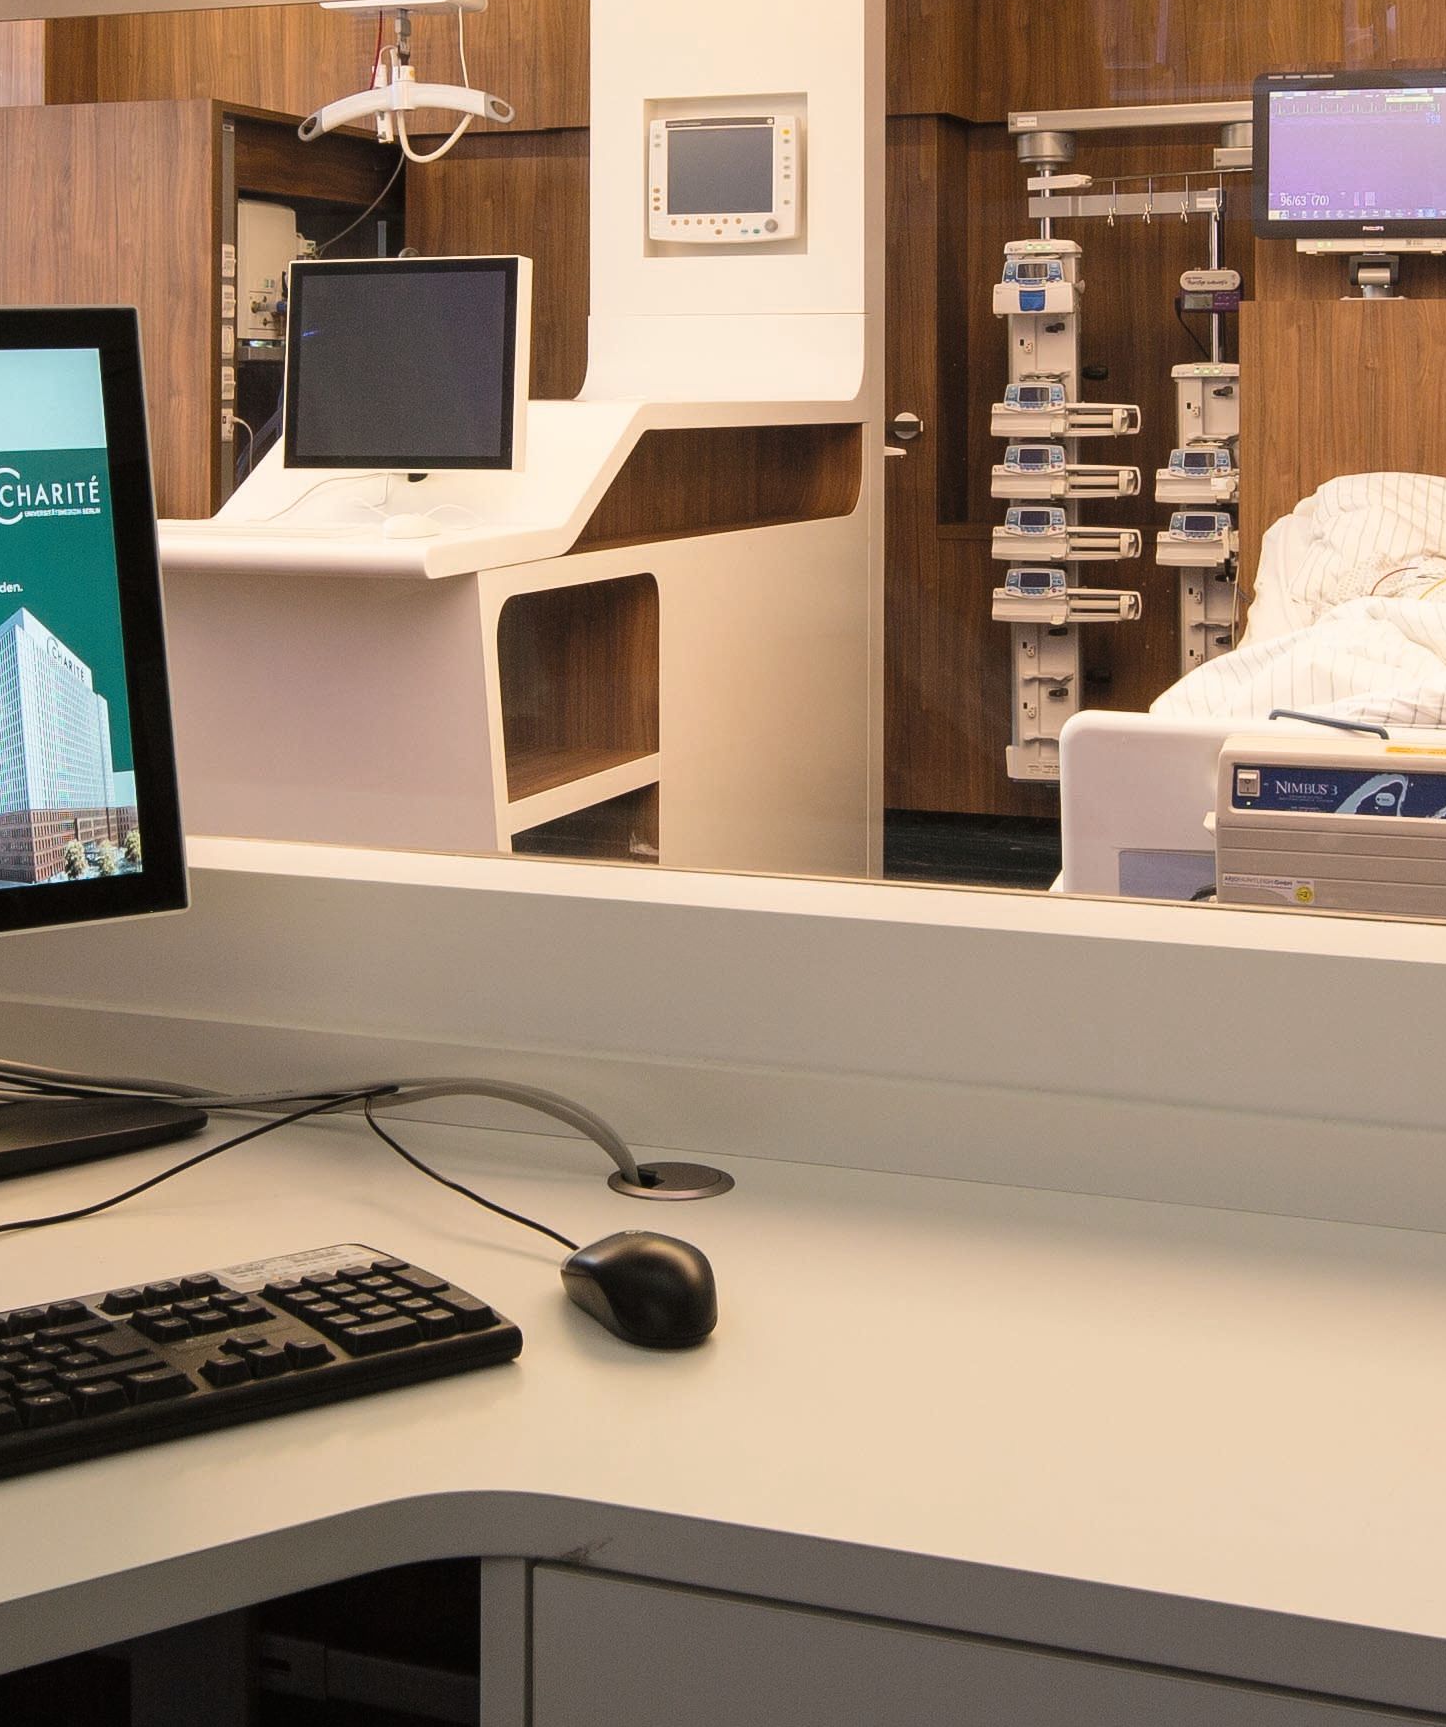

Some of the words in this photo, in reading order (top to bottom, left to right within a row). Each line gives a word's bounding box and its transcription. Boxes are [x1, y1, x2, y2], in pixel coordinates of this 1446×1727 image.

[1280, 195, 1307, 206] 96/63
[1311, 195, 1330, 206] (70)
[0, 475, 100, 507] CHARITÉ
